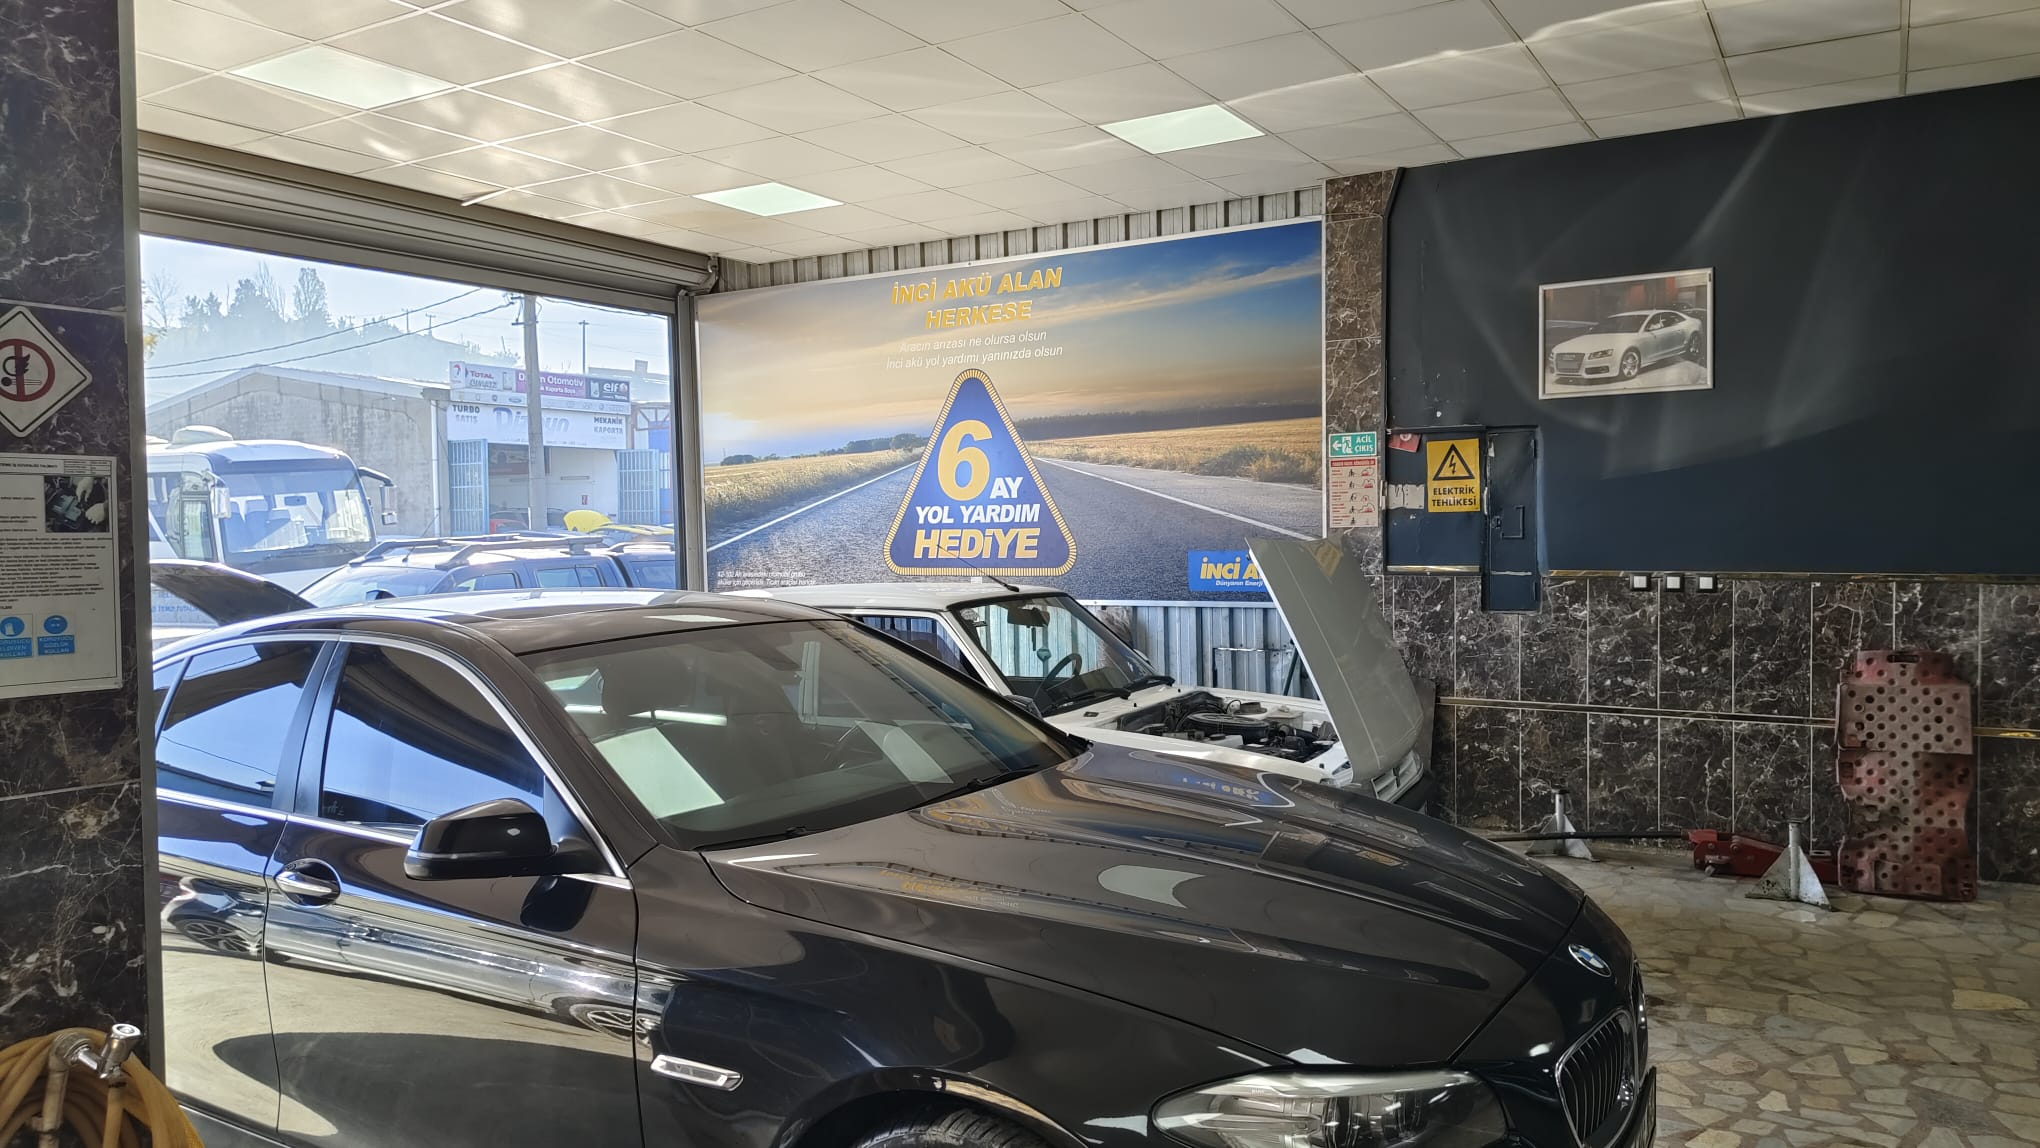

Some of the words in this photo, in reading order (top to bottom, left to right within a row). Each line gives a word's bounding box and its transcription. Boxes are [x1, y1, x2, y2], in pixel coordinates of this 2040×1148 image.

[891, 278, 937, 304] İNCİ
[943, 272, 992, 299] AKÜ
[997, 267, 1063, 295] ALAN
[925, 300, 1033, 330] HERKESE
[900, 340, 931, 353] Aracın
[933, 338, 966, 350] arızası
[969, 336, 982, 347] ne
[984, 332, 1016, 346] olursa
[1018, 330, 1047, 342] olsun
[905, 357, 923, 368] akü
[925, 355, 940, 369] yol
[942, 353, 979, 368] yardımı
[981, 348, 1031, 364] yanınızda
[1034, 345, 1063, 358] olsun
[470, 370, 494, 379] TOTAL
[547, 376, 583, 387] Otomotiv
[603, 382, 619, 392] elf
[452, 405, 480, 413] TURBO
[1356, 435, 1372, 443] ACİL
[1355, 444, 1374, 453] ÇIKIŞ
[937, 419, 993, 501] 6
[989, 477, 1024, 499] AY
[1433, 485, 1475, 495] ELEKTRİK
[1432, 496, 1476, 507] TEHLİKESİ
[915, 505, 954, 524] YOL
[960, 504, 1041, 524] YARDIM
[1200, 556, 1241, 579] İNCİ
